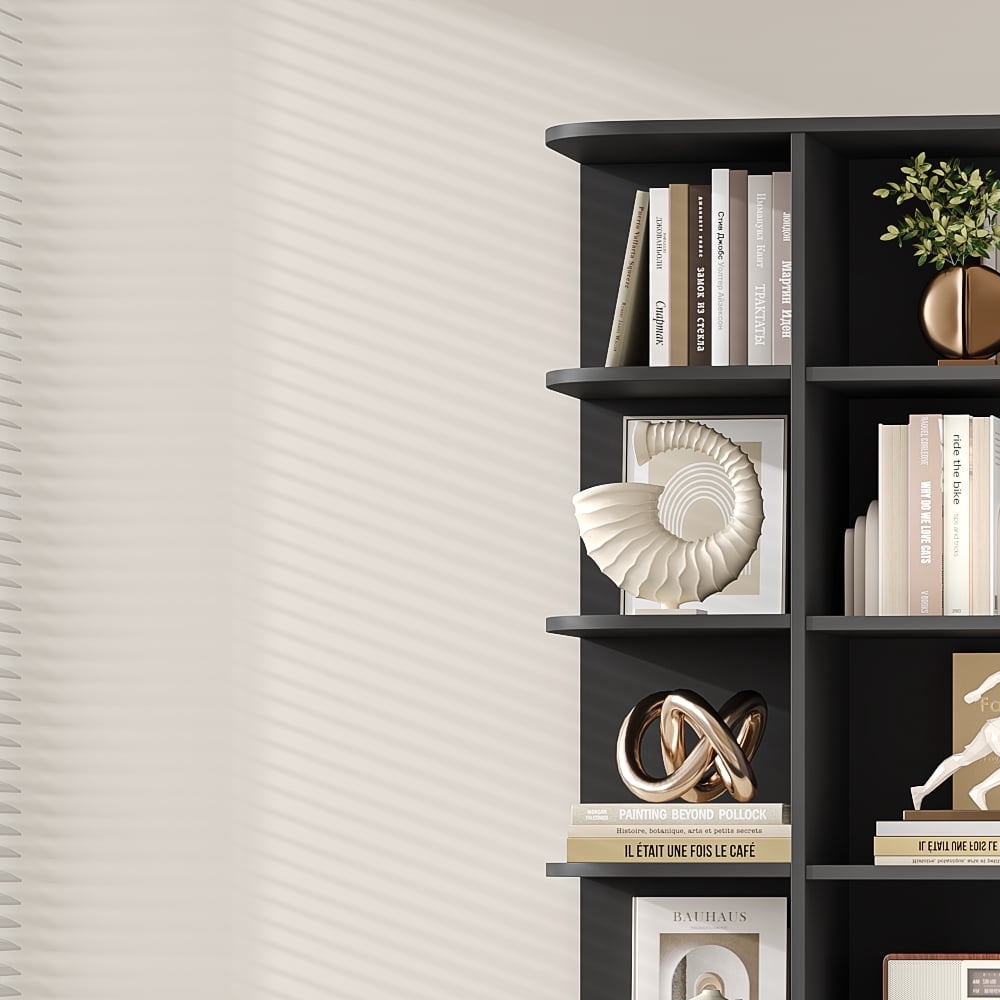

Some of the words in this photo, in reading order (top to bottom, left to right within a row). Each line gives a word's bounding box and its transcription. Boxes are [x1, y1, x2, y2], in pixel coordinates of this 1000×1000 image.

[717, 211, 725, 231] Стив
[717, 232, 725, 260] Джобс
[697, 267, 705, 298] замок
[697, 302, 705, 314] из
[755, 284, 766, 346] ТРАКТАТЫ
[653, 300, 664, 346] Спартак
[697, 318, 705, 352] стекла
[953, 434, 962, 456] ride
[953, 459, 961, 478] the
[921, 481, 931, 499] WHY
[953, 481, 962, 505] bike
[921, 500, 931, 511] DO
[921, 512, 931, 524] WE
[921, 525, 931, 544] LOVE
[921, 545, 931, 564] CATS
[619, 808, 667, 821] PAINTING
[672, 808, 714, 821] BEYOND
[718, 808, 767, 821] POLLOCK
[625, 844, 634, 857] IL
[637, 841, 665, 857] ÉTAIT
[667, 844, 688, 857] UNE
[690, 844, 713, 857] FOIS
[716, 844, 727, 857] LE
[729, 841, 756, 857] CAFÉ
[673, 911, 747, 922] BAUHAUS
